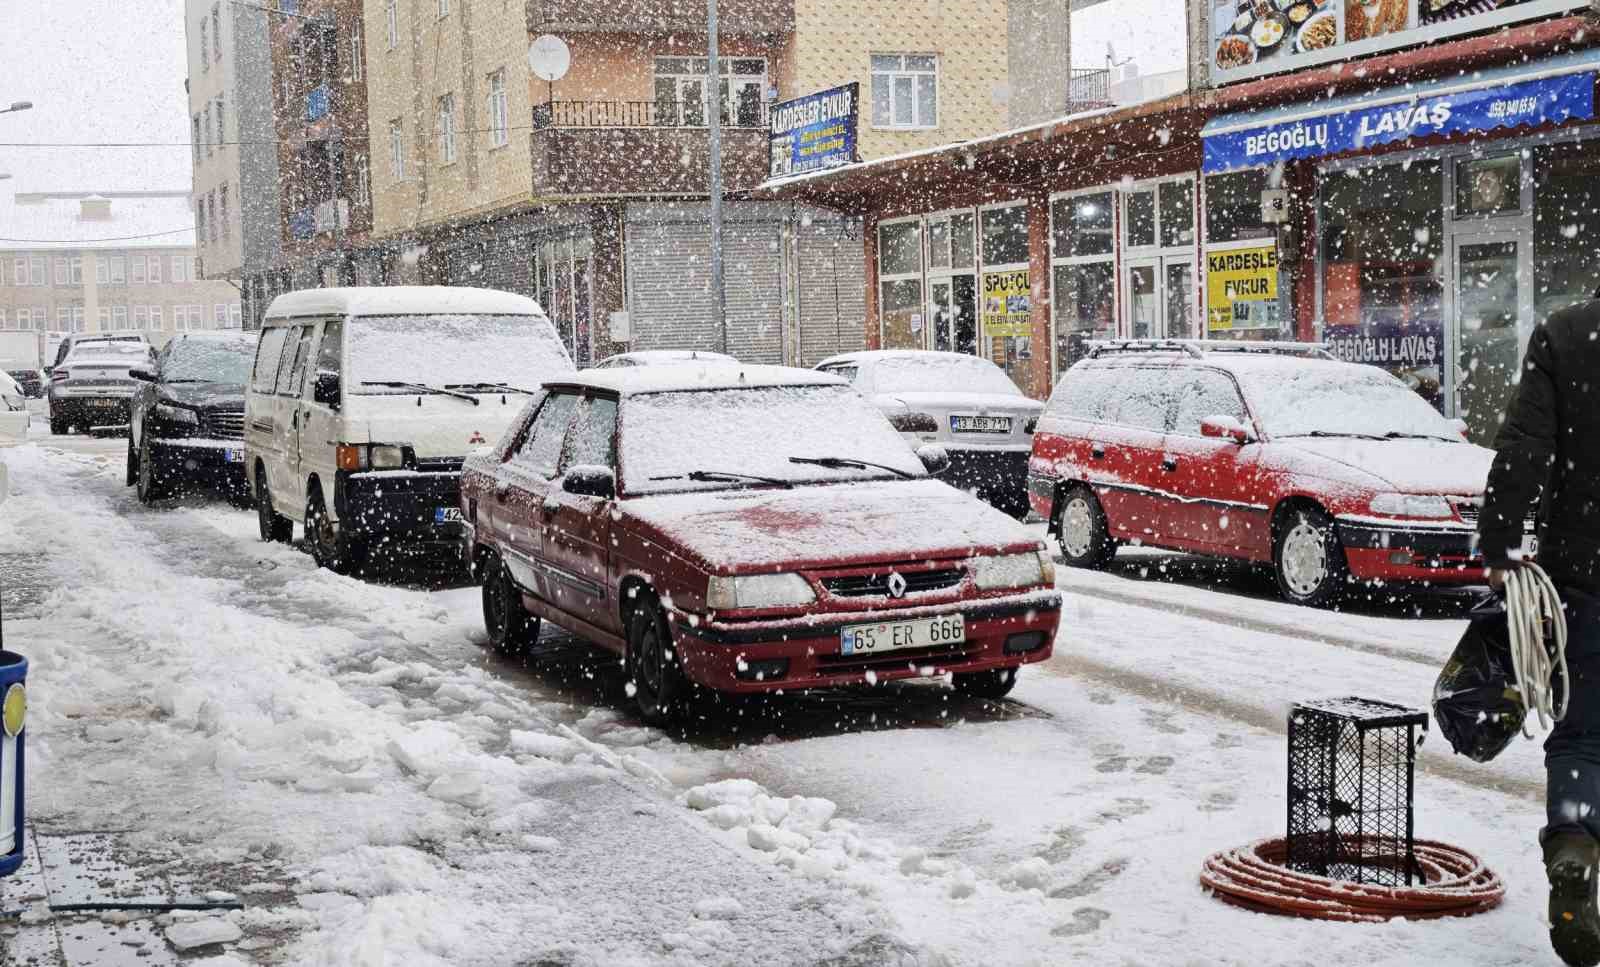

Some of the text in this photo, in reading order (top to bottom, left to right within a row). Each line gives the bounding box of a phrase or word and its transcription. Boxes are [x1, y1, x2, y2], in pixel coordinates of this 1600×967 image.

[821, 91, 851, 122] EVKUR
[1360, 101, 1452, 140] LAVAŞ
[1225, 278, 1268, 297] EVKUR
[1391, 335, 1437, 366] LAVAŞ
[445, 508, 459, 521] 42
[854, 620, 961, 649] 65 ER 666
